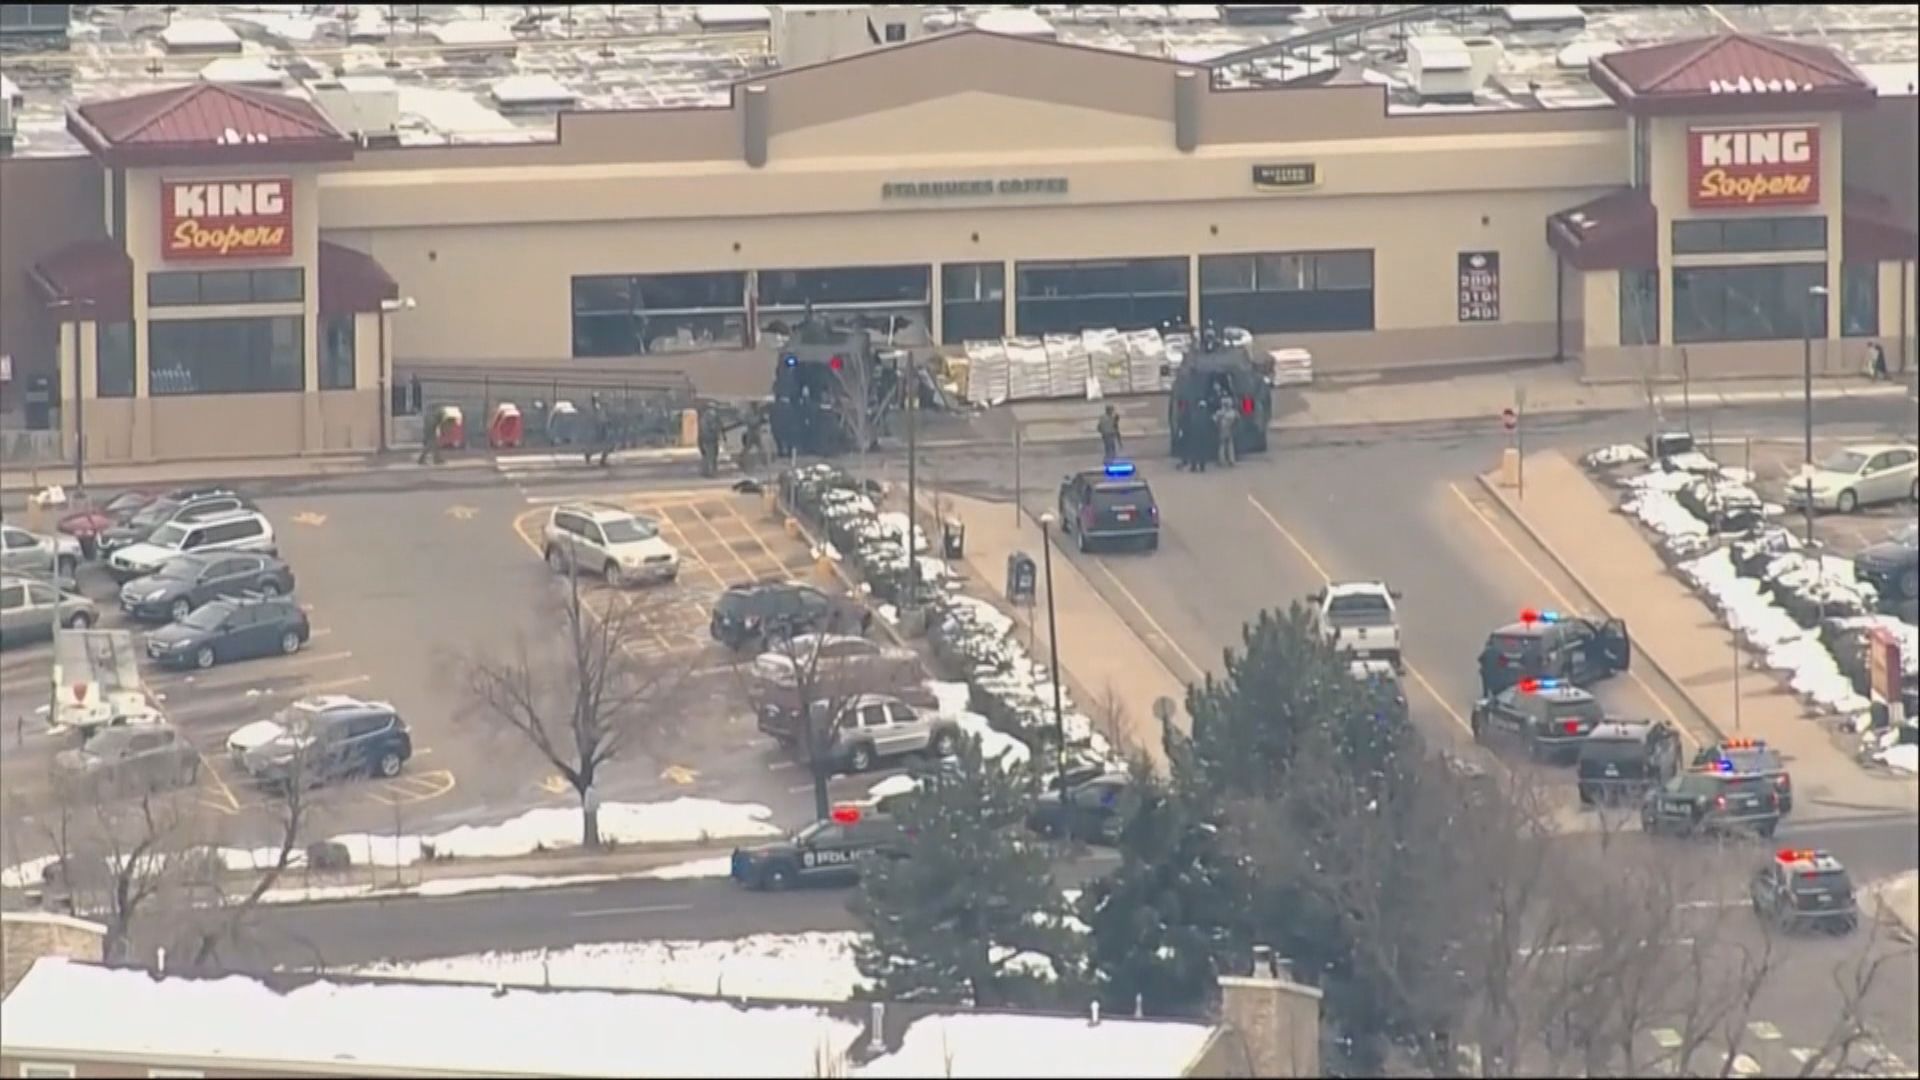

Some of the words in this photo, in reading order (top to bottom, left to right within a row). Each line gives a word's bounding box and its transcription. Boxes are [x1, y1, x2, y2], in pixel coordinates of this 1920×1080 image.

[1702, 131, 1811, 165] KING
[174, 183, 284, 217] KING
[1698, 168, 1812, 203] Soopers
[171, 219, 285, 255] Soopers
